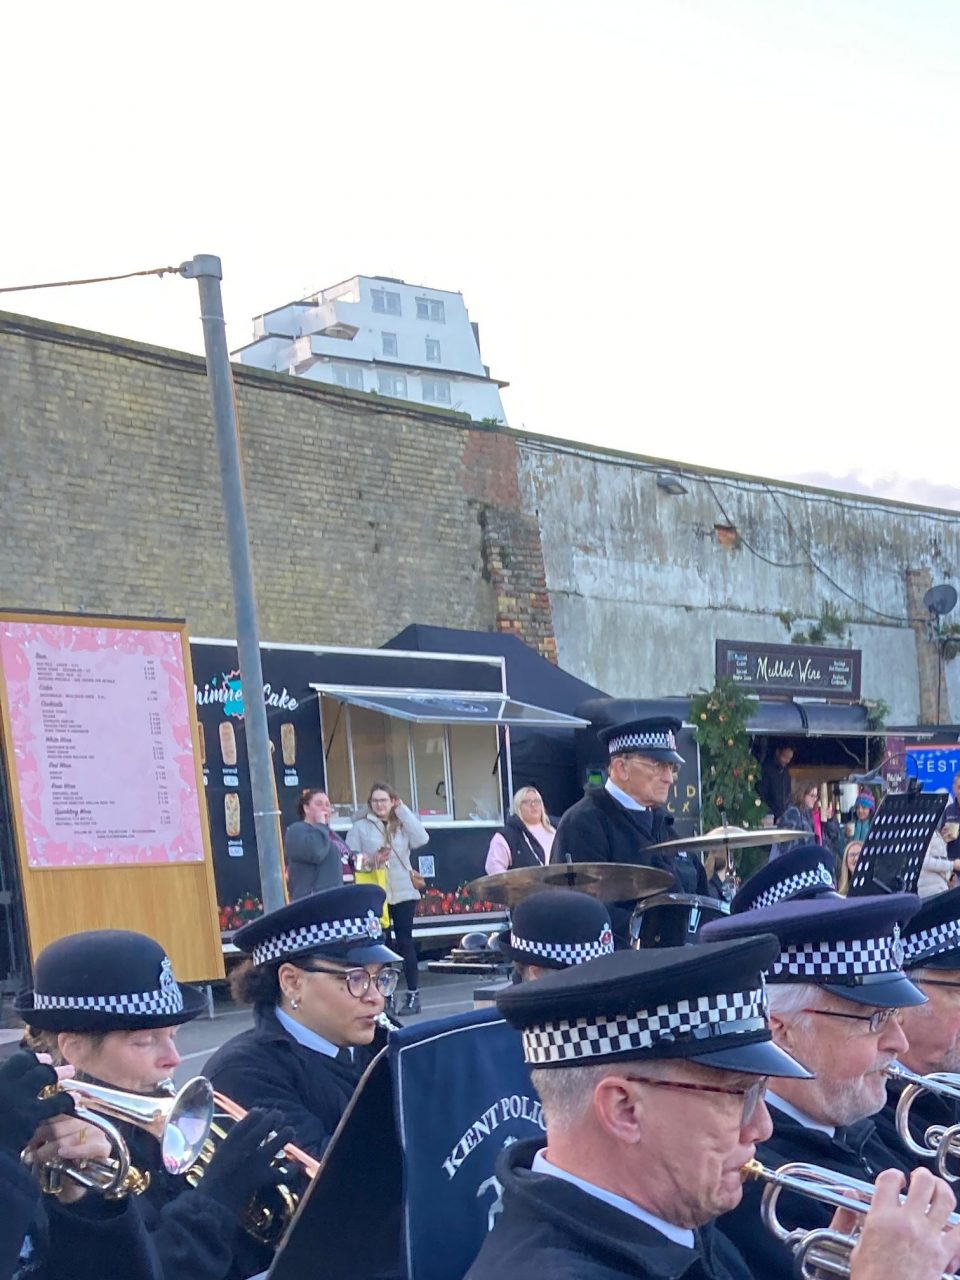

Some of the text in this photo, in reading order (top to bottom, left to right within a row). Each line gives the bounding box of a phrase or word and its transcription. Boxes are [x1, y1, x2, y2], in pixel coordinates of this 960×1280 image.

[757, 656, 821, 683] Mulled Wine
[194, 684, 243, 706] himne
[440, 1094, 549, 1181] KENT POLIC
